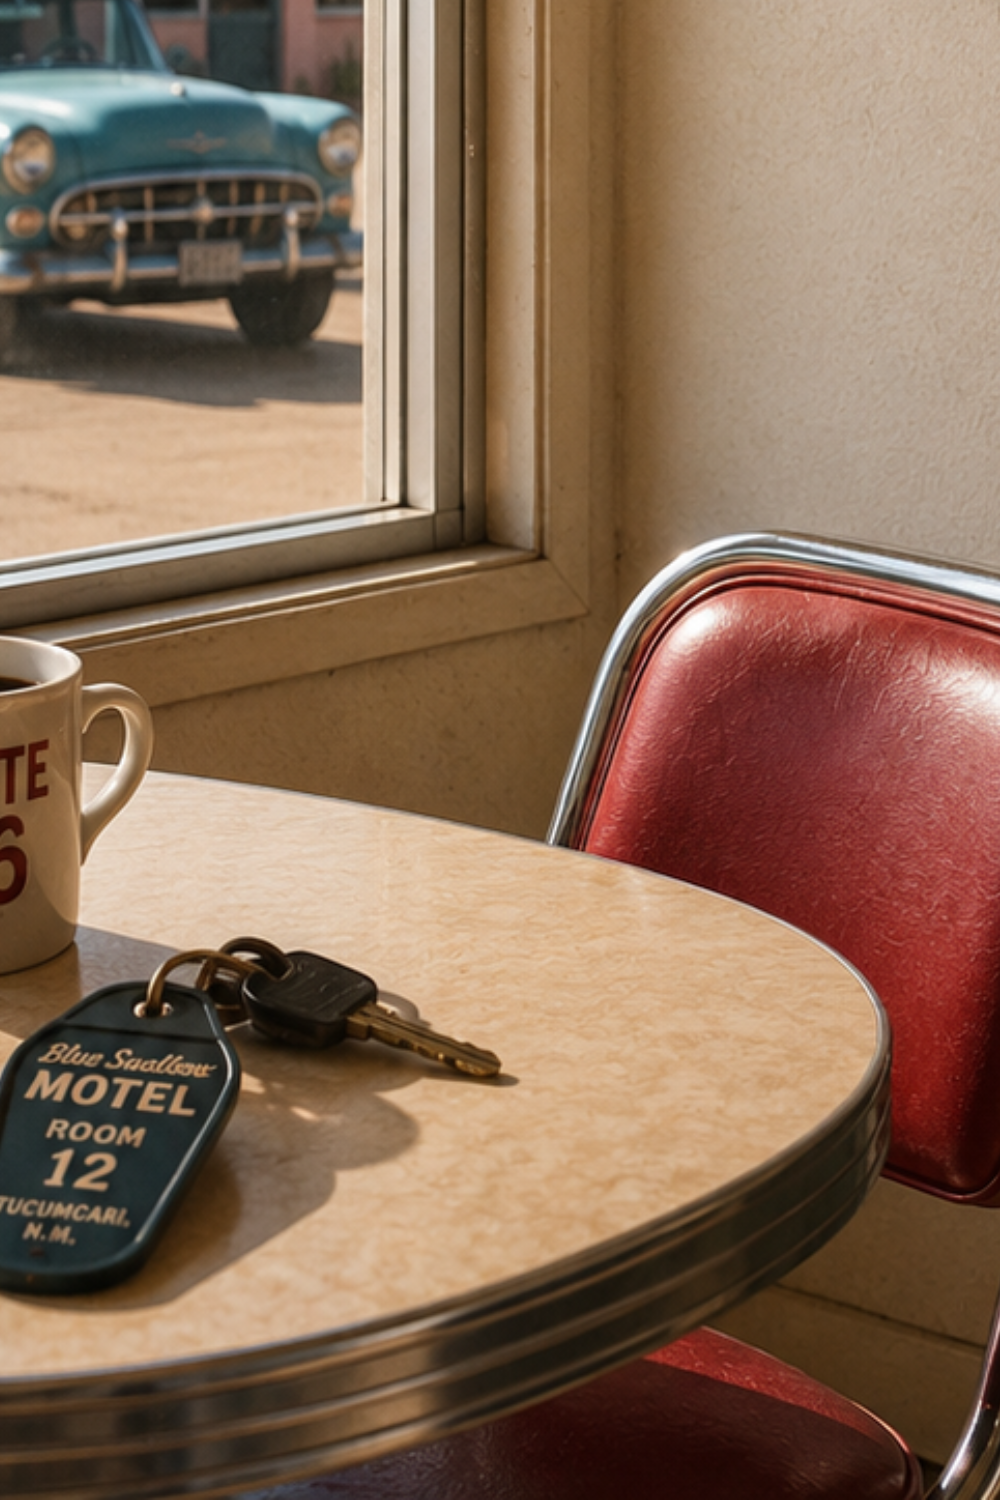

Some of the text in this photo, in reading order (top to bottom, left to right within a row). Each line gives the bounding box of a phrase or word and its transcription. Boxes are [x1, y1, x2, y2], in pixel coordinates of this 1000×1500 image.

[38, 1042, 104, 1068] Blue
[24, 1068, 196, 1117] MOTEL
[45, 1118, 147, 1149] ROOM
[43, 1147, 118, 1193] 12
